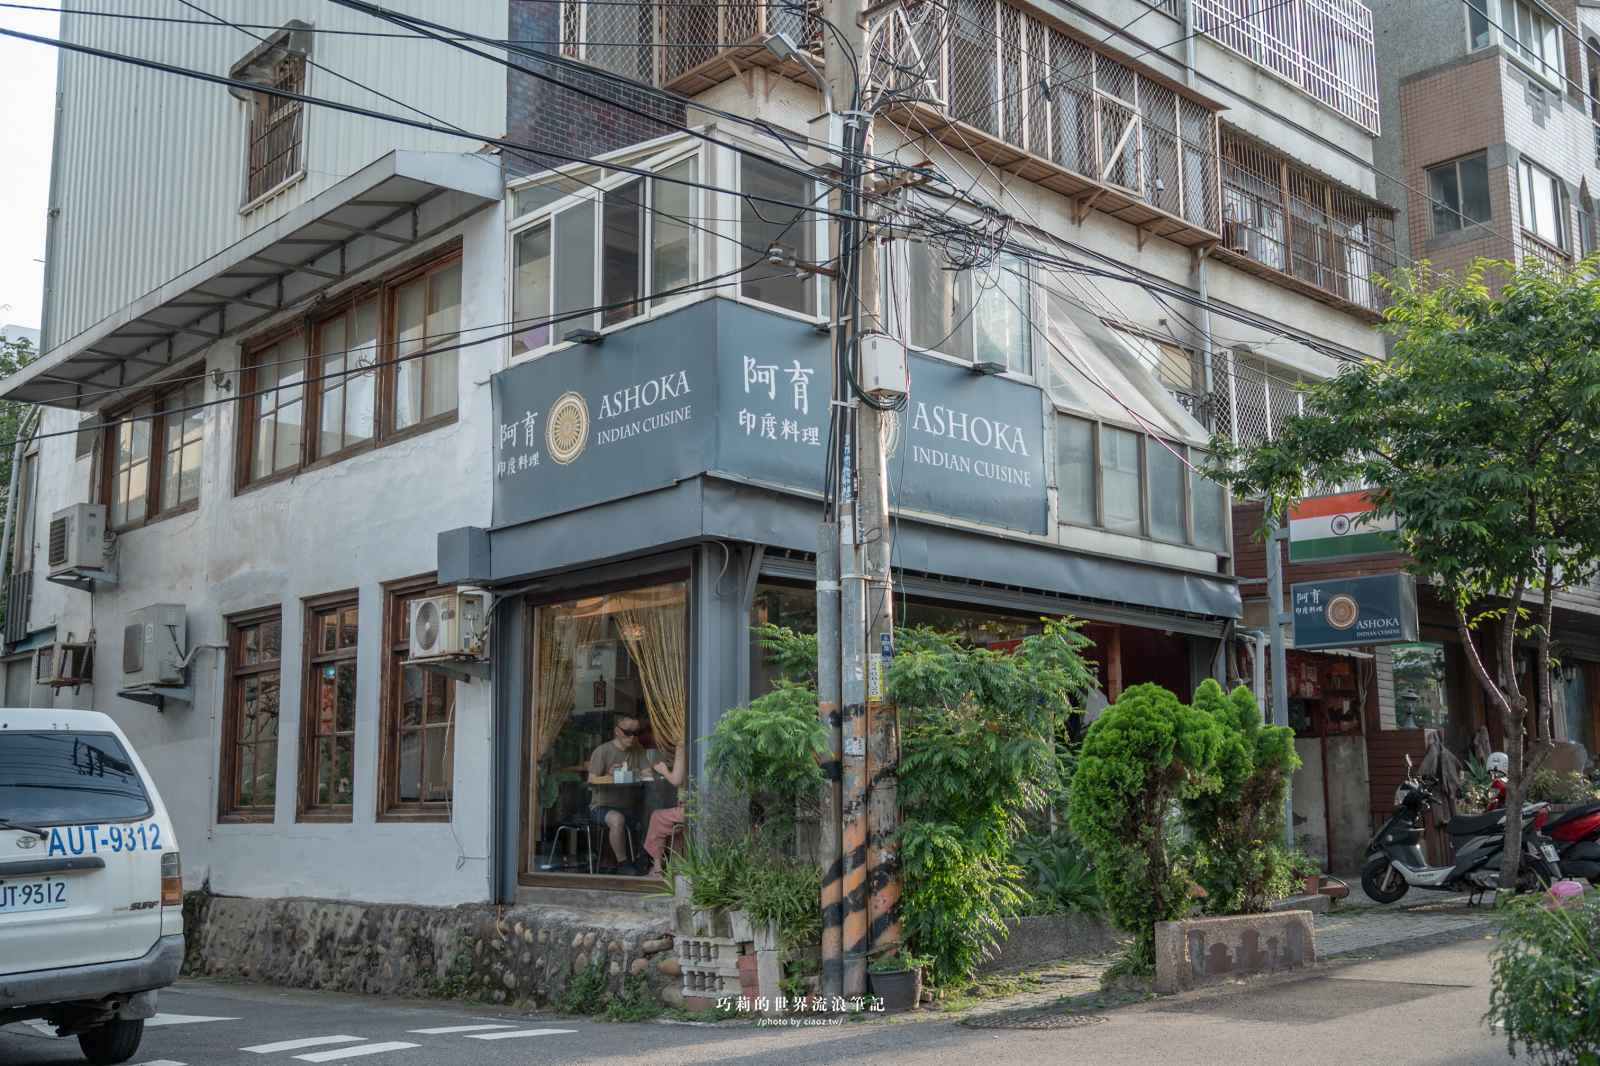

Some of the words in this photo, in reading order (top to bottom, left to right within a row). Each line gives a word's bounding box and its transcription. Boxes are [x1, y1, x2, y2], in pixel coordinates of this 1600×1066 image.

[597, 369, 692, 420] ASHOKA
[743, 355, 815, 415] 阿育
[499, 410, 539, 450] 阿育
[597, 421, 642, 446] INDIAN
[642, 405, 692, 434] CUISINE
[737, 407, 822, 446] 印度料理
[911, 401, 1031, 458] ASHOKA
[497, 451, 540, 480] 印度料理
[913, 445, 971, 474] INDIAN
[973, 459, 1032, 488] CUISINE
[1356, 617, 1400, 630] ASHOKA
[48, 823, 162, 857] AUT-9312
[129, 900, 160, 911] SURF
